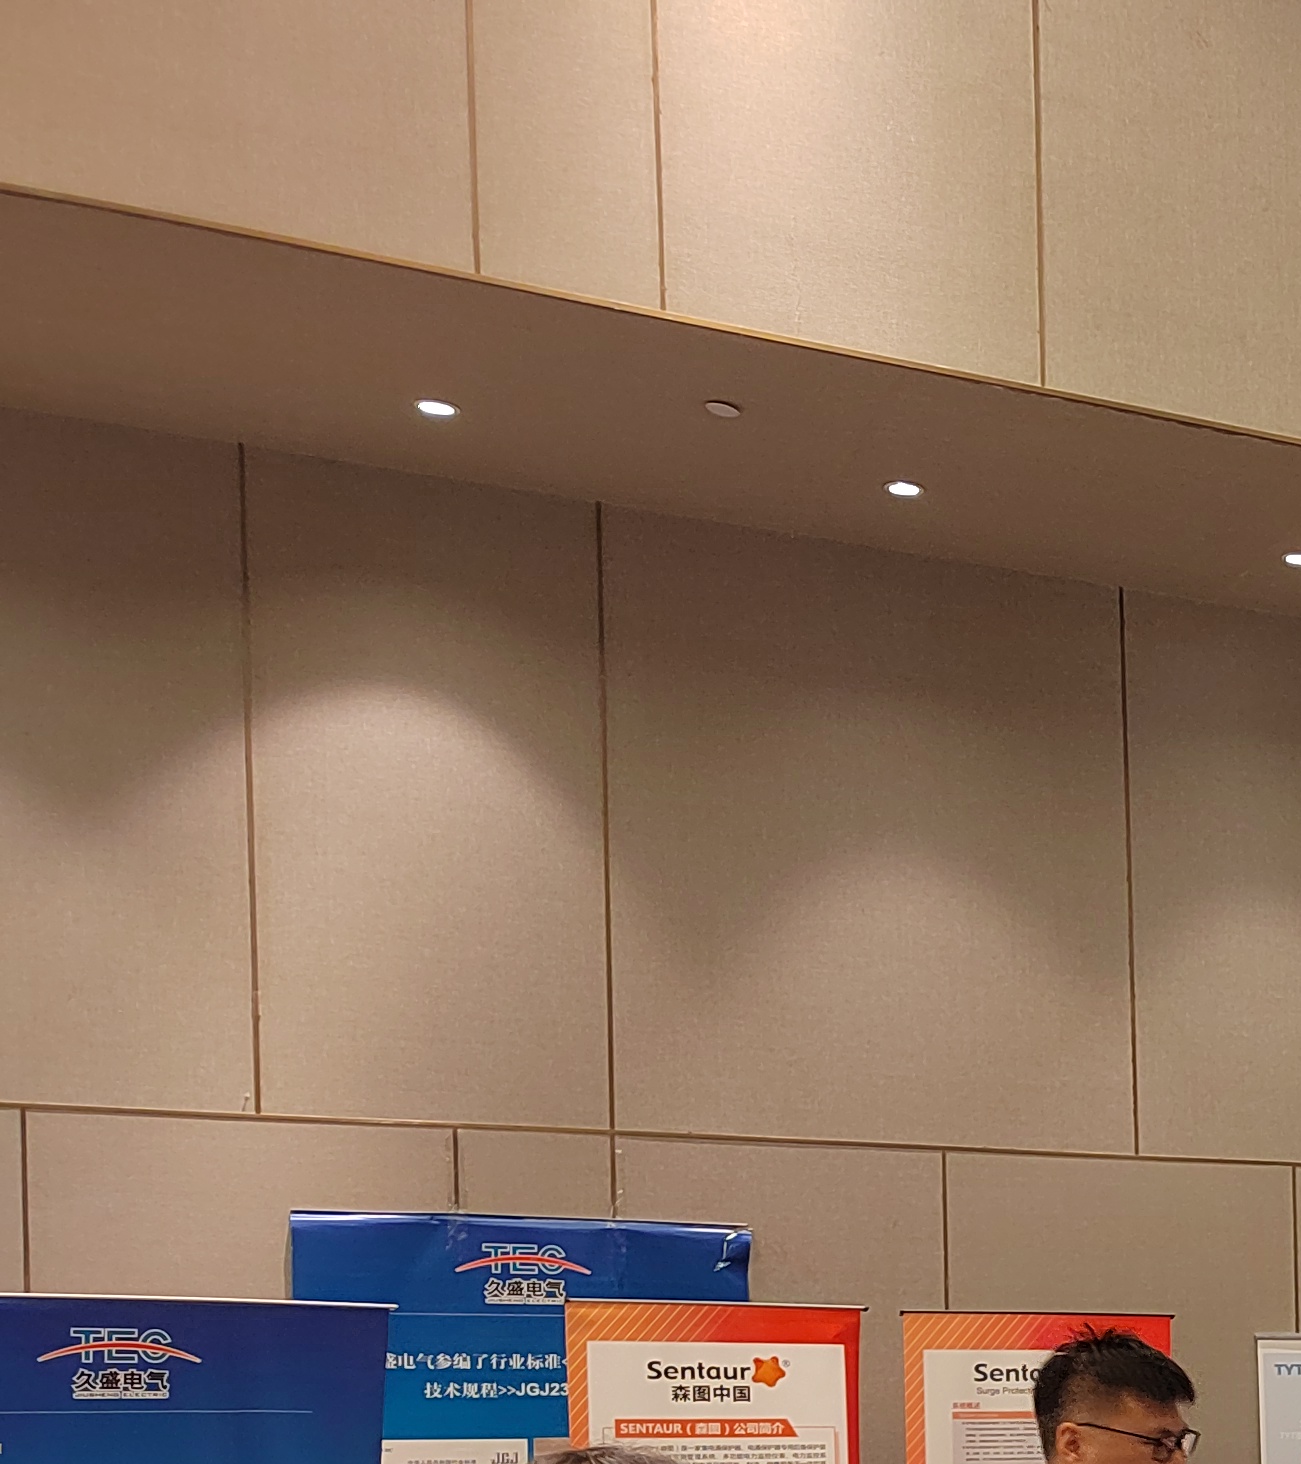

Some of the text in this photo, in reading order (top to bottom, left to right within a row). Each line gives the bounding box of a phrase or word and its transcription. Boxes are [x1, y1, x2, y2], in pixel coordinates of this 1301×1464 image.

[482, 1243, 566, 1275] TEC
[484, 1279, 566, 1299] 久盛电气
[70, 1327, 172, 1364] TEC
[72, 1369, 170, 1392] 久盛电气
[647, 1361, 751, 1381] Sentaur
[671, 1385, 751, 1402] 森图中国
